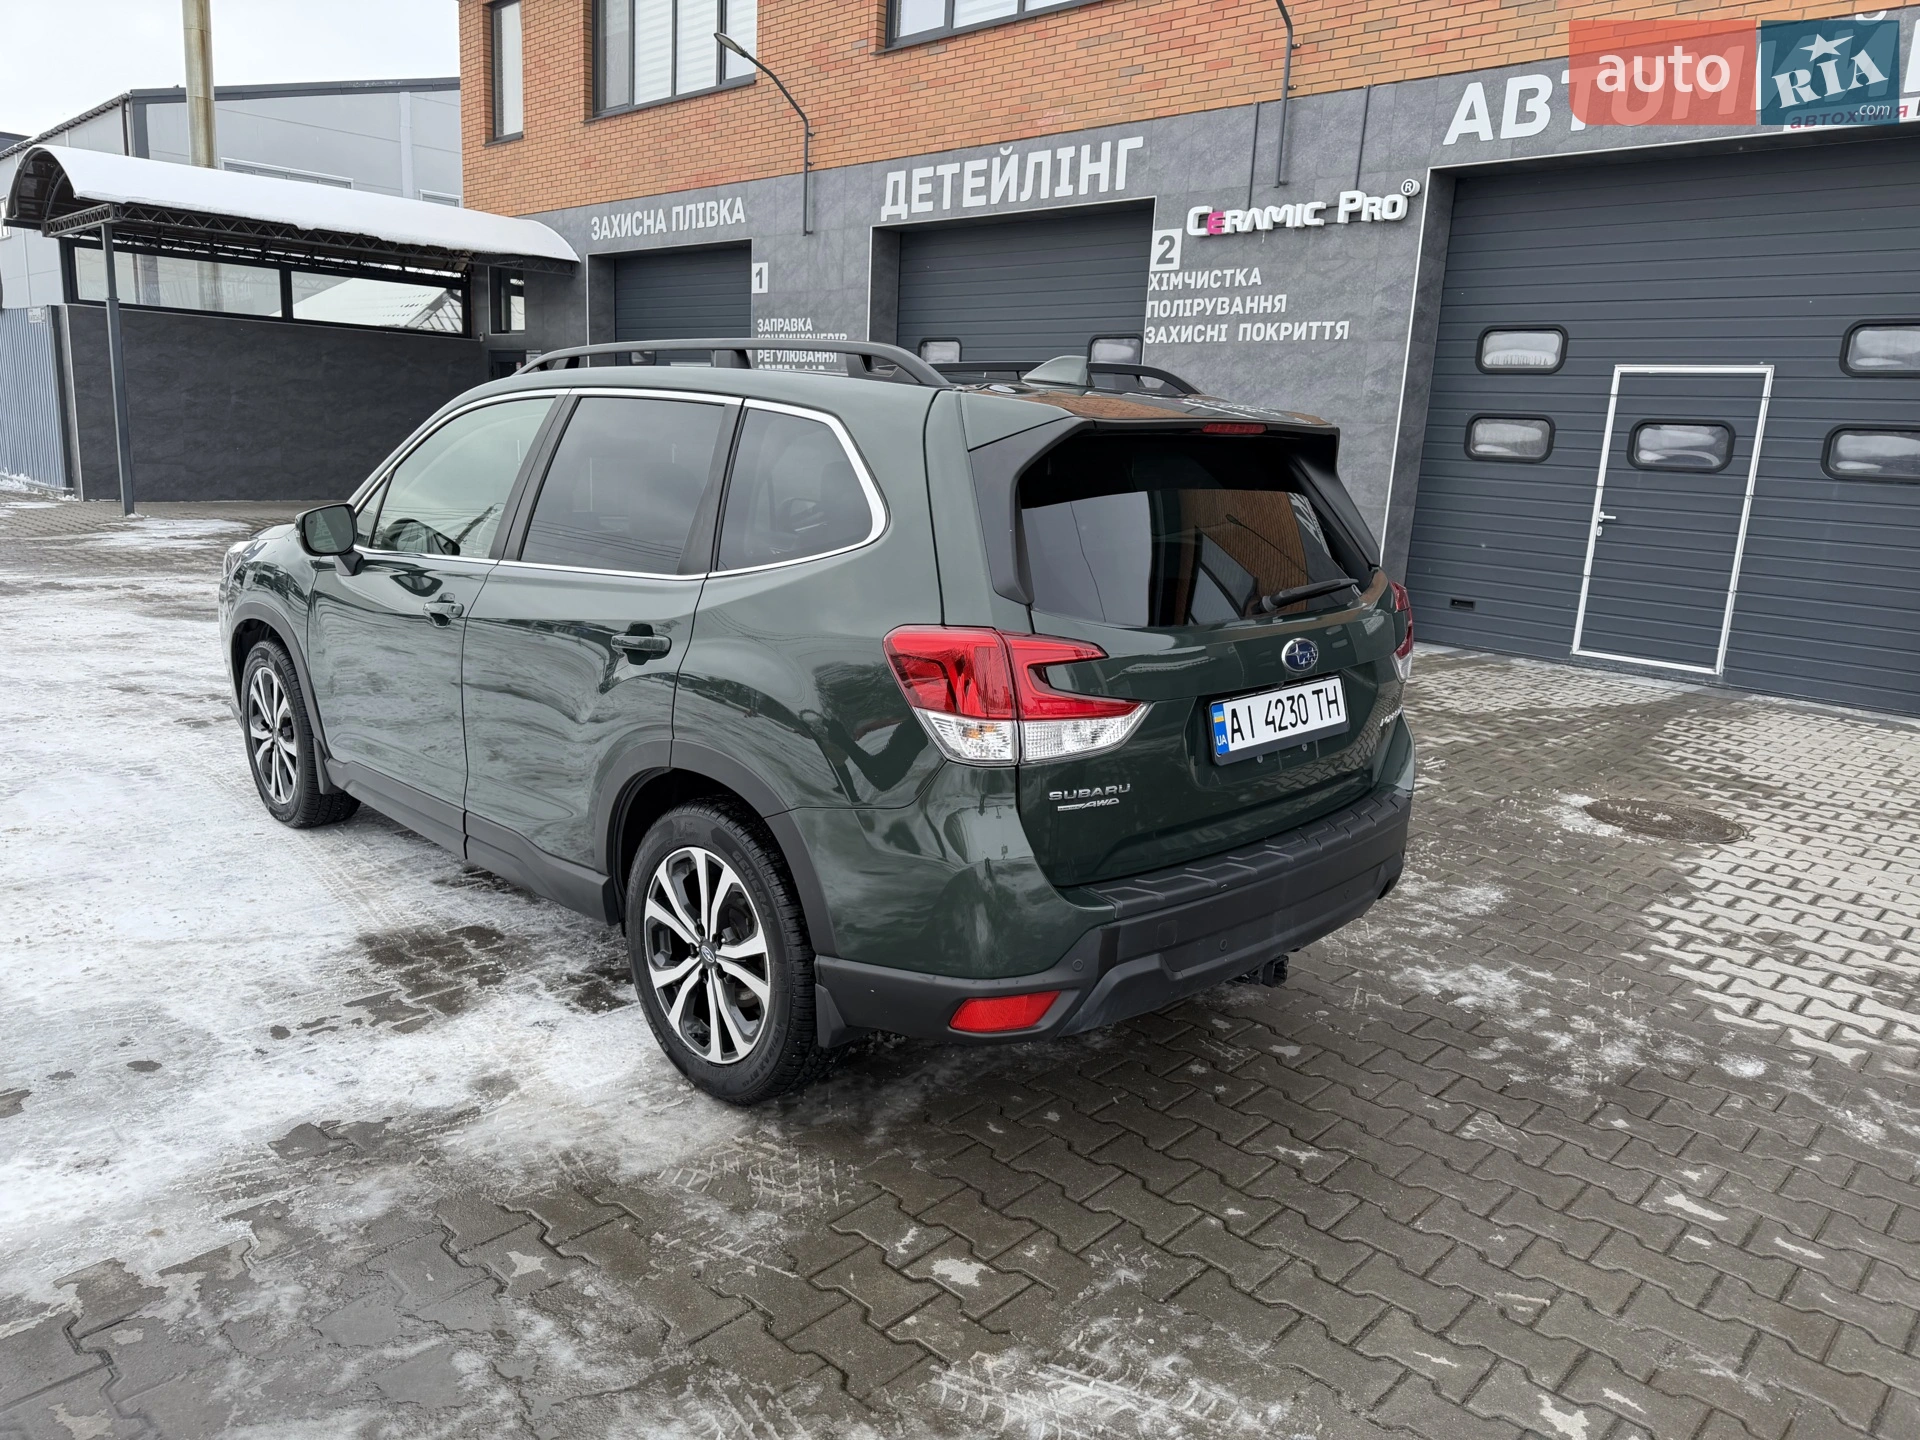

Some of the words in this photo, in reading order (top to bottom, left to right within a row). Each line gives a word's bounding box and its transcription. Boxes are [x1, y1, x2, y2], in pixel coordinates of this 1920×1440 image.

[880, 136, 1144, 222] ДЕТЕЙЛІНГ
[590, 208, 667, 241] ЗАХИСНА
[671, 196, 746, 232] ПЛІВКА
[1155, 235, 1176, 266] 2
[755, 267, 764, 290] 1
[1149, 267, 1262, 292] ХІМЧИСТКА
[1147, 294, 1288, 318] ПОЛІРУВАННЯ
[757, 317, 813, 332] ЗАПРАВКА
[1144, 324, 1228, 344] ЗАХИСНІ
[1237, 320, 1350, 342] ПОКРИТТЯ
[757, 349, 837, 363] РЕГУЛЮВАННЯ
[1230, 705, 1256, 744] AI
[1264, 693, 1309, 733] 4230
[1312, 685, 1341, 721] TH
[1216, 734, 1228, 746] UA
[1048, 783, 1131, 801] SUBARU
[1081, 797, 1120, 810] AWD
